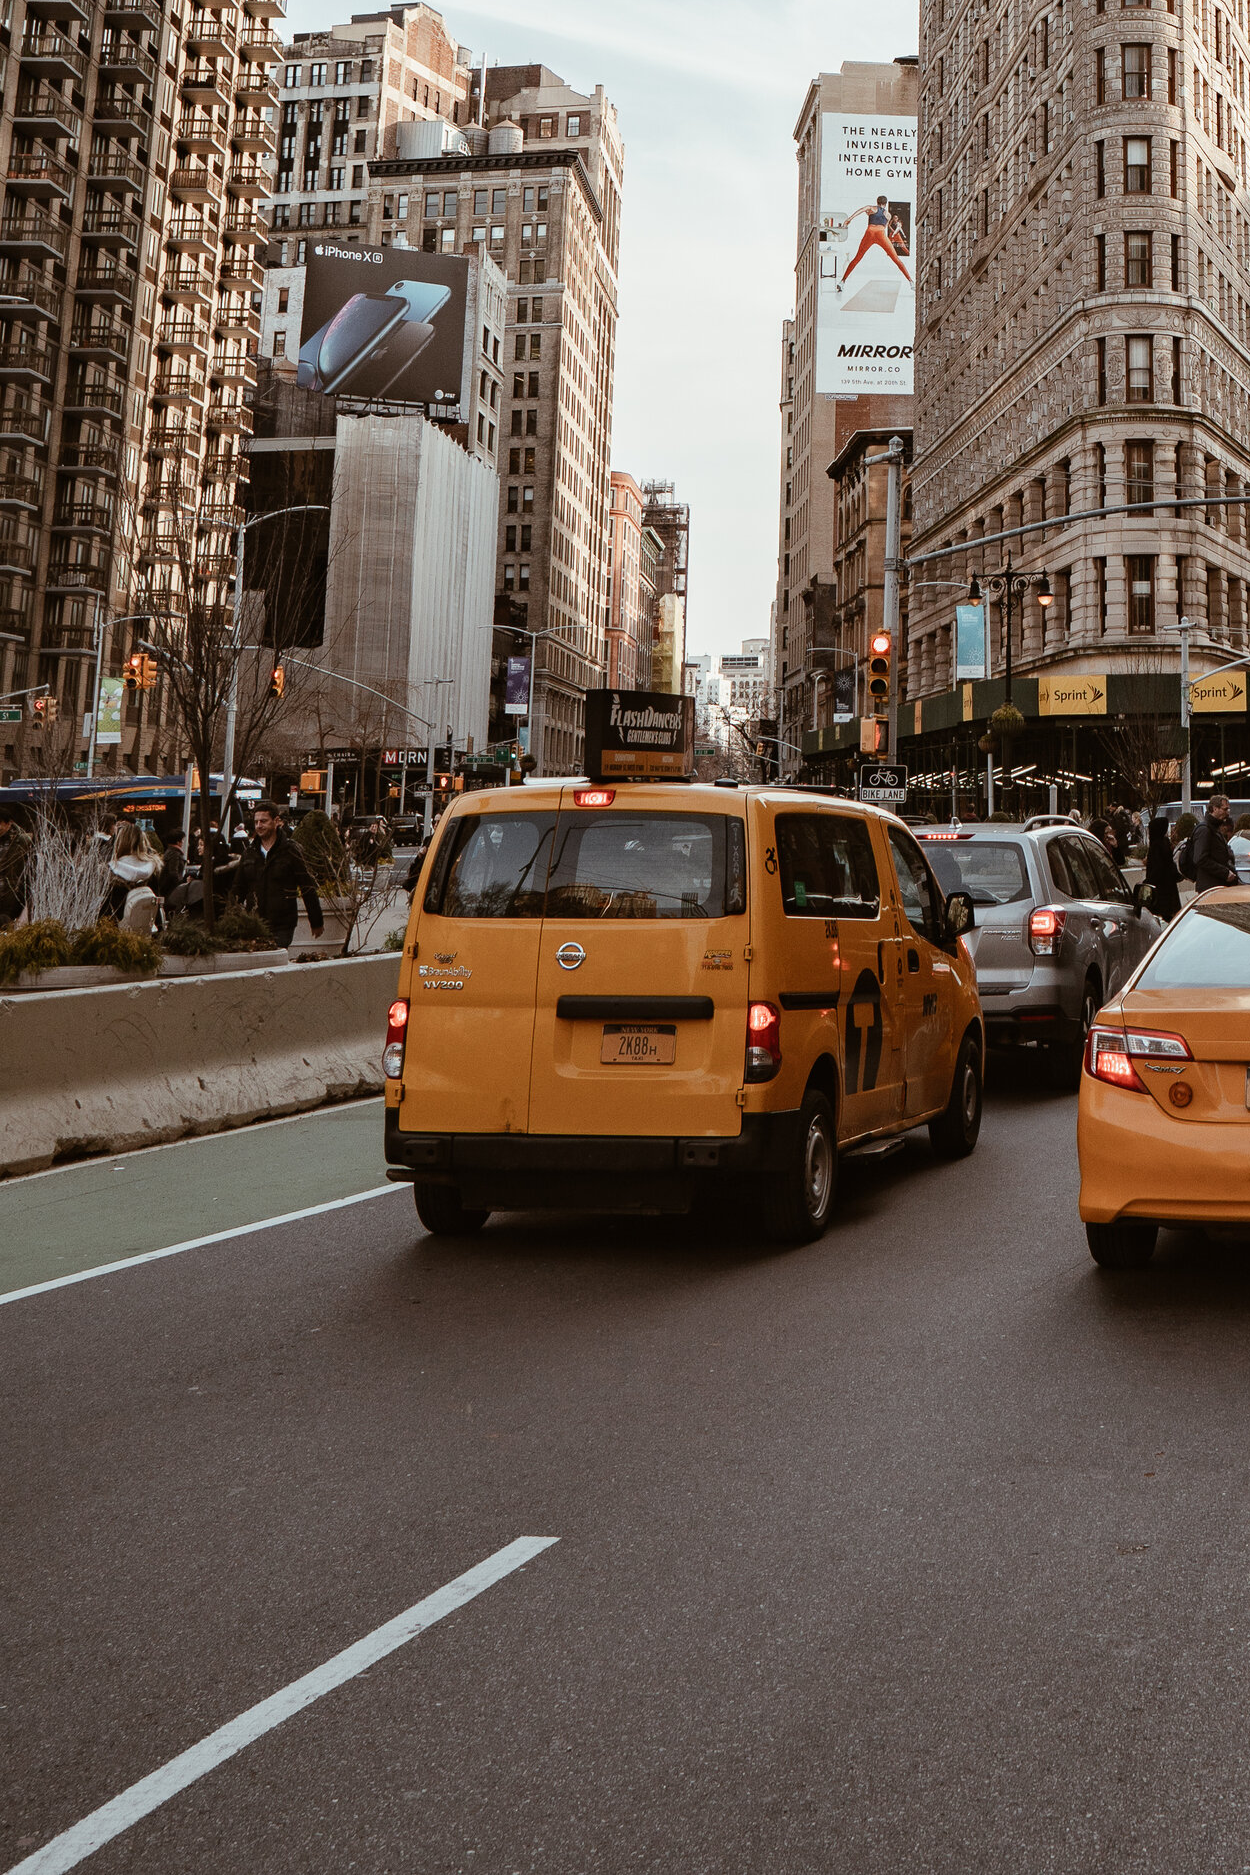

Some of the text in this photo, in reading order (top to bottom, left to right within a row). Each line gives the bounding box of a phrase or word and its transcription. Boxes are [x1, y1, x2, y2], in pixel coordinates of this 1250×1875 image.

[842, 126, 917, 138] THE NEARLY
[846, 140, 913, 152] INVISIBLE,
[838, 153, 918, 165] INTERACTIVE
[846, 168, 912, 179] HOME GYM
[324, 245, 362, 262] iPhone
[837, 344, 914, 359] MIRROR
[847, 365, 901, 373] MIRROR.CO
[1054, 689, 1088, 703] Sprint
[1193, 686, 1228, 701] Sprint
[862, 789, 904, 800] BIKE LANE
[423, 980, 464, 990] NV200
[621, 1026, 639, 1034] NEW
